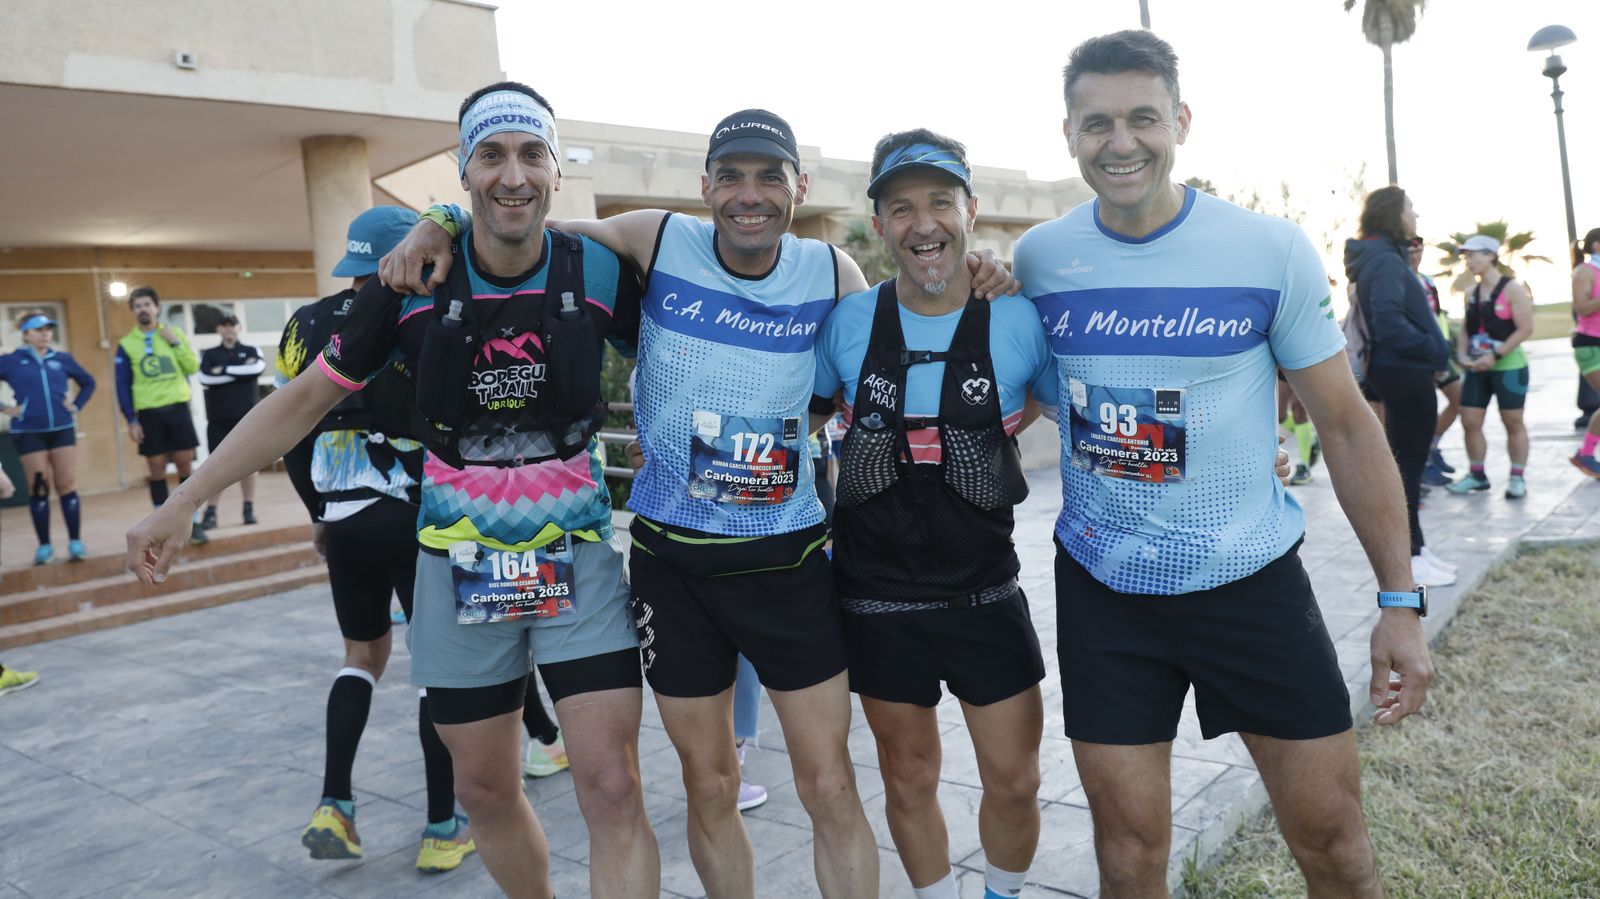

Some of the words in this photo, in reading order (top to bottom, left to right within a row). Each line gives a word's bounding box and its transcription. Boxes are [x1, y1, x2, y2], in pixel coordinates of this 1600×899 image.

[467, 114, 543, 144] NINGUNO
[731, 122, 787, 139] LURBEL
[347, 239, 373, 255] OKA
[662, 292, 705, 322] C.A.
[1084, 307, 1253, 339] Montellano
[475, 380, 539, 406] TRAIL
[487, 397, 527, 411] UBRIQUE
[869, 388, 899, 412] MAX
[1099, 402, 1138, 437] 93
[730, 432, 775, 464] 172
[1079, 440, 1140, 460] Carbonera
[1143, 450, 1179, 463] 2023
[704, 469, 769, 486] Carbonera
[770, 474, 795, 485] 2023
[487, 550, 538, 580] 164
[470, 591, 536, 603] Carbonera
[538, 586, 570, 598] 2023
